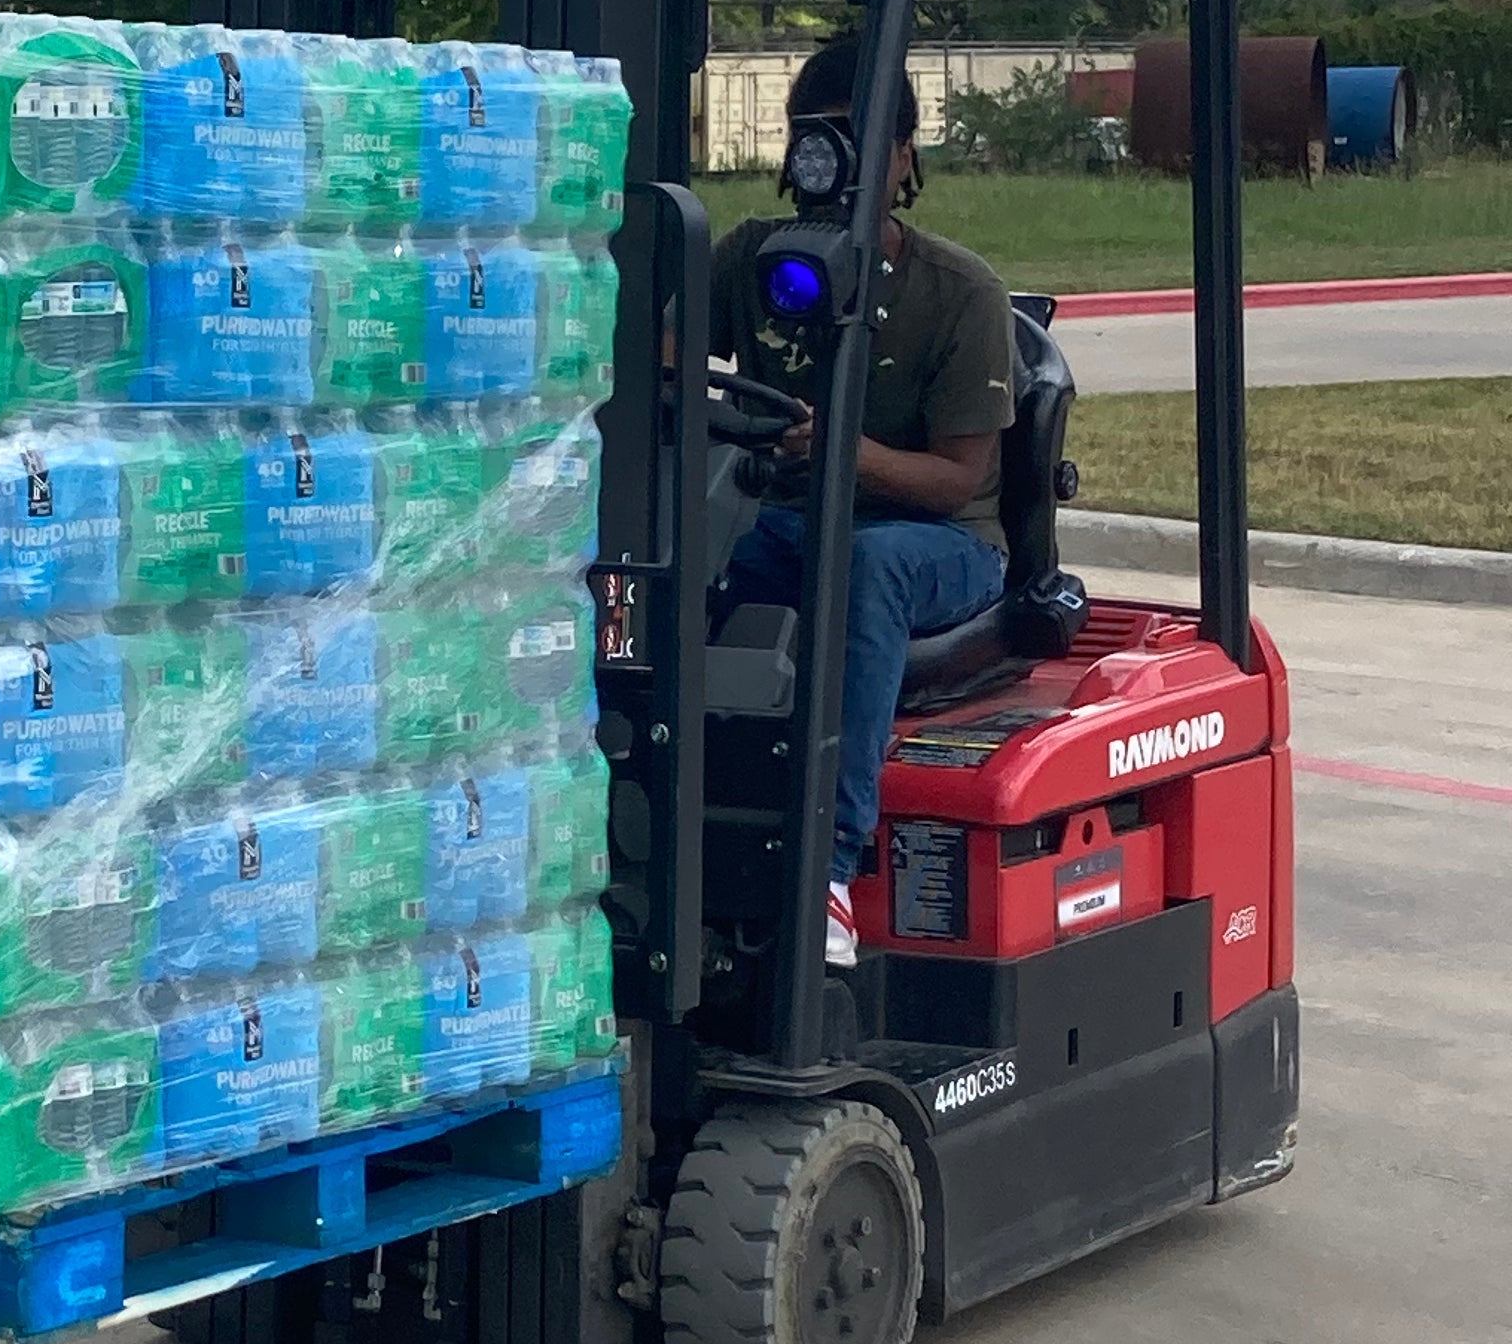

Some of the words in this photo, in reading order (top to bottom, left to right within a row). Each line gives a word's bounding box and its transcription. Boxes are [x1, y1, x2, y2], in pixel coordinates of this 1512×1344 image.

[435, 272, 461, 289] 40
[258, 460, 285, 477] 40
[65, 516, 122, 538] WATER
[1108, 711, 1226, 778] RAYMOND
[934, 1061, 1016, 1113] 4460C35S
